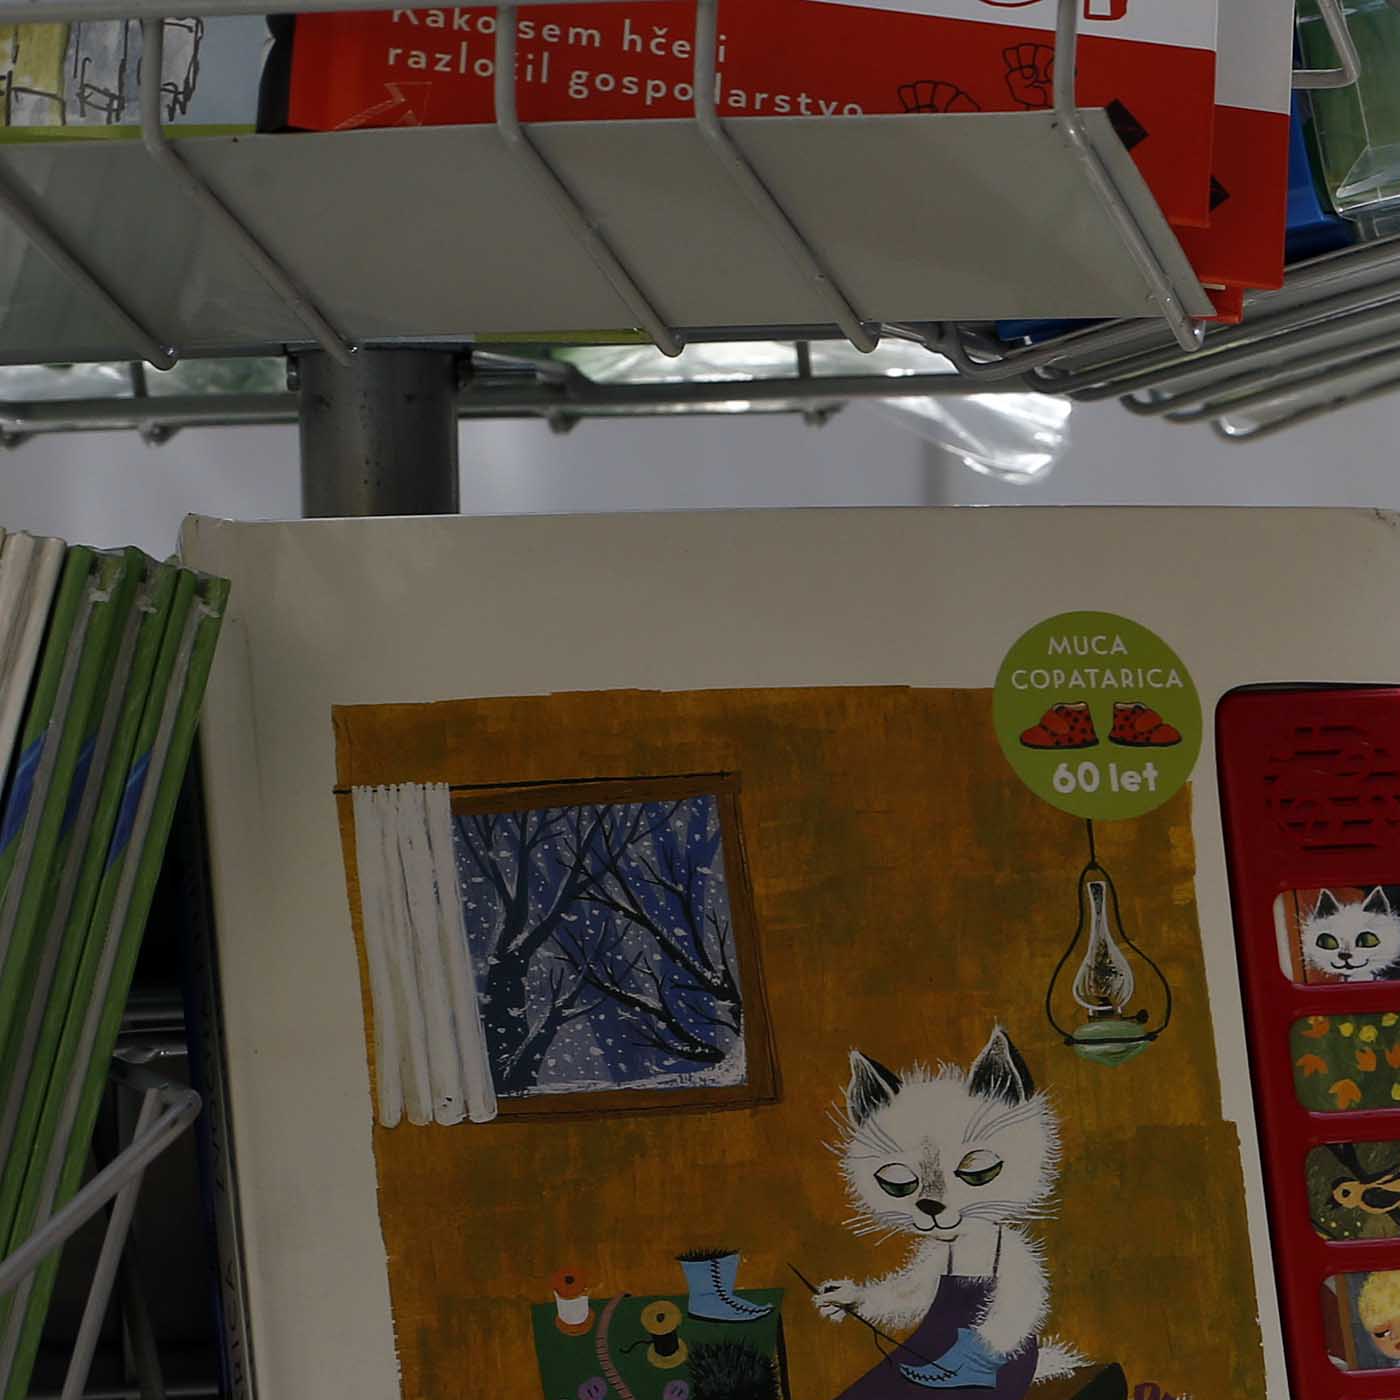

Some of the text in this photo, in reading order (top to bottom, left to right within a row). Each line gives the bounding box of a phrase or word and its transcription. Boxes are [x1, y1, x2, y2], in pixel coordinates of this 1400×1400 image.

[391, 8, 727, 62] Kako sem hčei
[388, 41, 549, 84] razloil
[1047, 634, 1128, 656] MUCA
[1011, 668, 1184, 690] COPATARICA
[1052, 761, 1158, 793] 60 let
